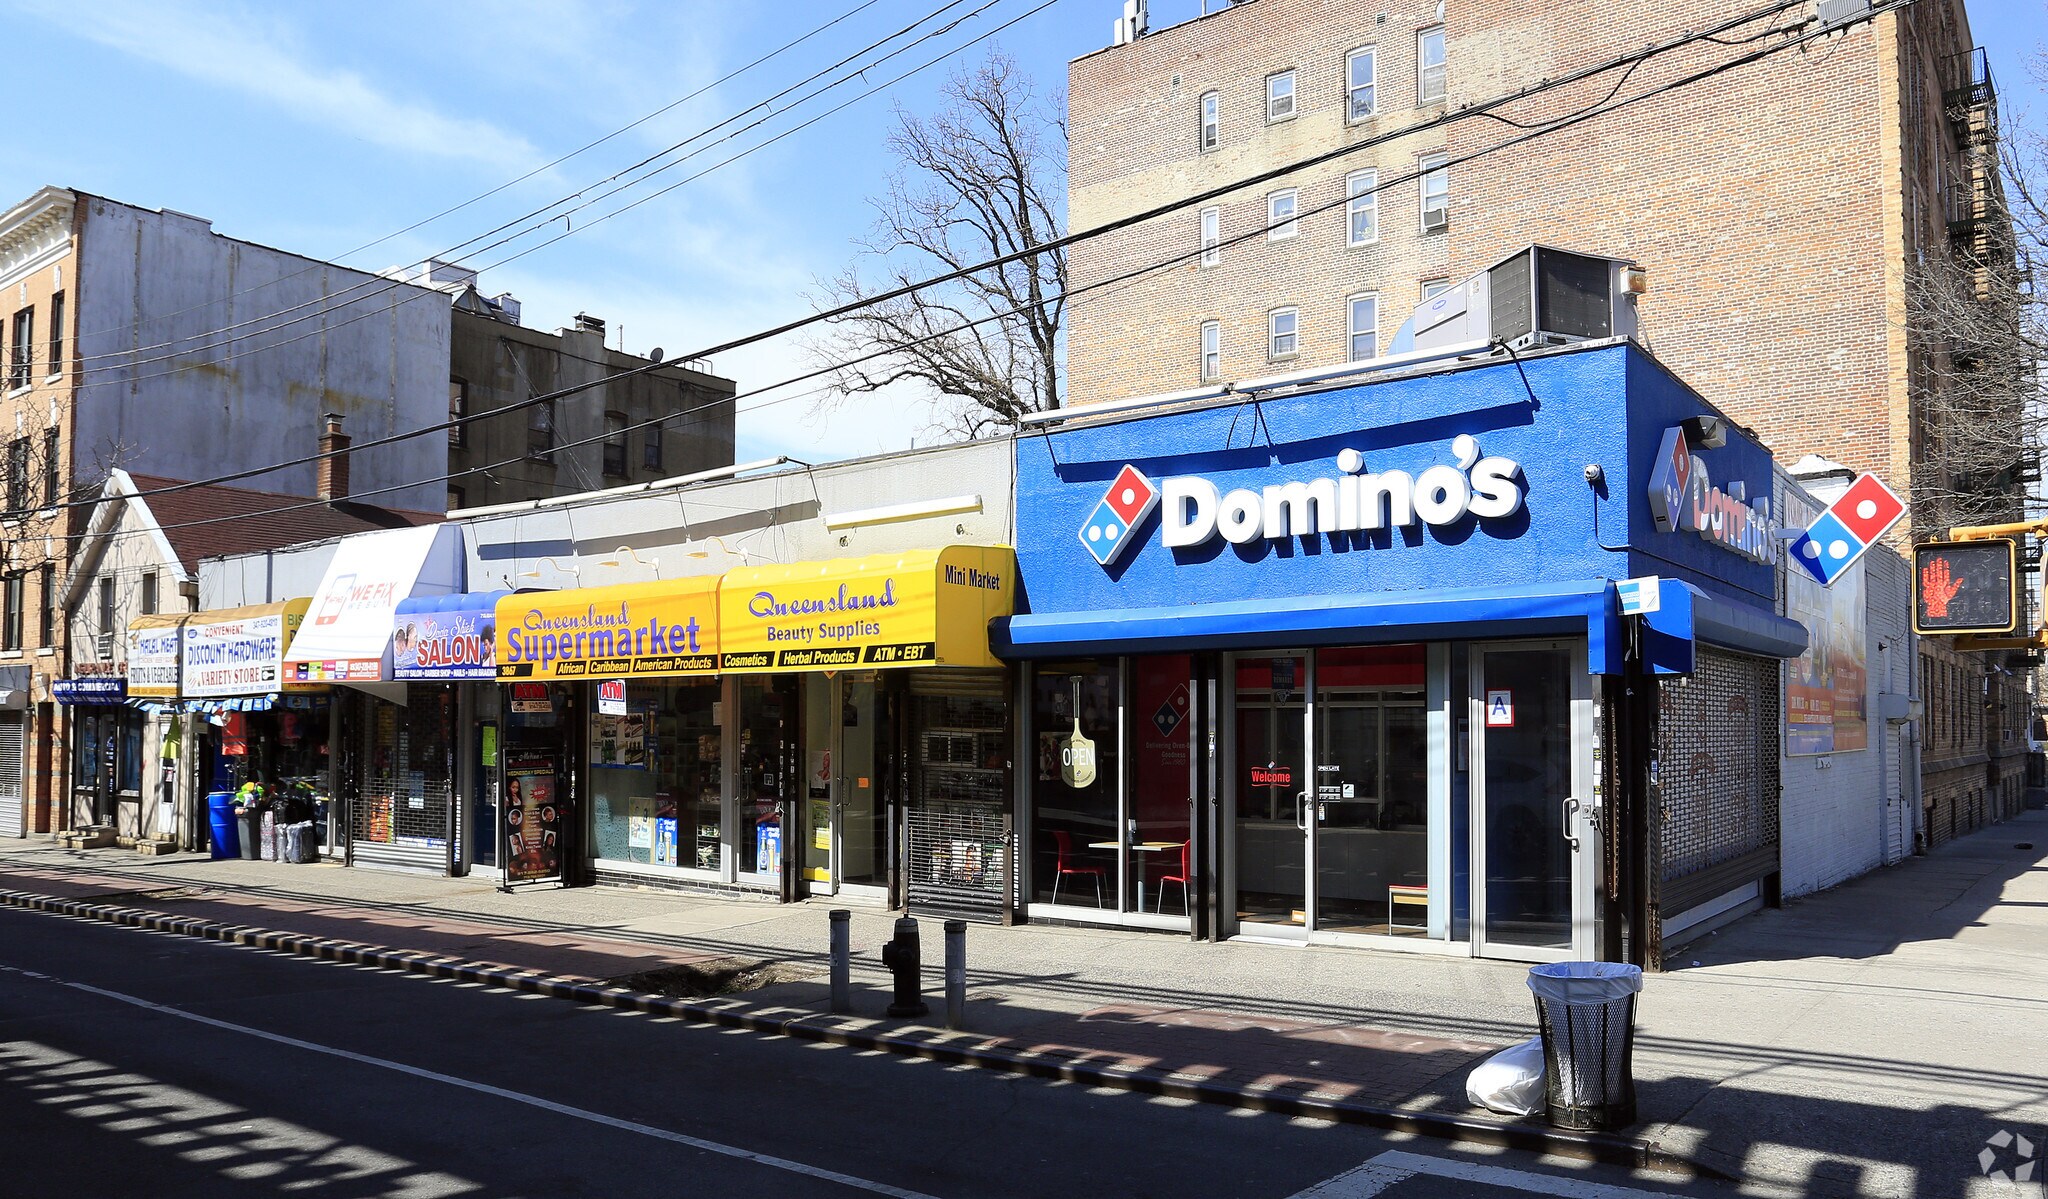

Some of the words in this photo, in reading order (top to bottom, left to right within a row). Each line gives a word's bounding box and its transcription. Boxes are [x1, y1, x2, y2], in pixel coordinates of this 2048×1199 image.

[1161, 433, 1522, 549] Domino's
[1692, 454, 1777, 567] Domino's
[944, 564, 966, 586] Mini
[969, 568, 1000, 591] Market
[351, 584, 373, 602] WE
[748, 578, 899, 618] Queensland
[523, 600, 632, 631] Queensland
[204, 624, 244, 638] CONVENIENT
[767, 626, 814, 644] Beauty
[818, 619, 880, 642] Supplies
[140, 639, 158, 654] HALAL
[160, 637, 178, 652] MEAT
[188, 642, 226, 666] DISCOUNT
[228, 637, 276, 664] HARDWARE
[416, 635, 480, 667] SALON
[506, 616, 701, 671] Supermarket
[873, 647, 896, 662] ATM
[903, 644, 926, 660] EBT
[590, 660, 629, 673] Caribbean
[634, 658, 673, 671] American
[674, 656, 712, 670] Products
[724, 654, 768, 668] Cosmetics
[784, 651, 812, 665] Herbal
[813, 650, 856, 664] Products
[200, 669, 233, 686] VARIETY
[234, 667, 260, 684] STORE
[558, 662, 584, 674] African
[514, 682, 546, 700] ATM
[600, 681, 624, 700] ATM
[1492, 696, 1507, 716] A
[1062, 747, 1095, 767] OPEN
[1252, 770, 1291, 783] Welcome
